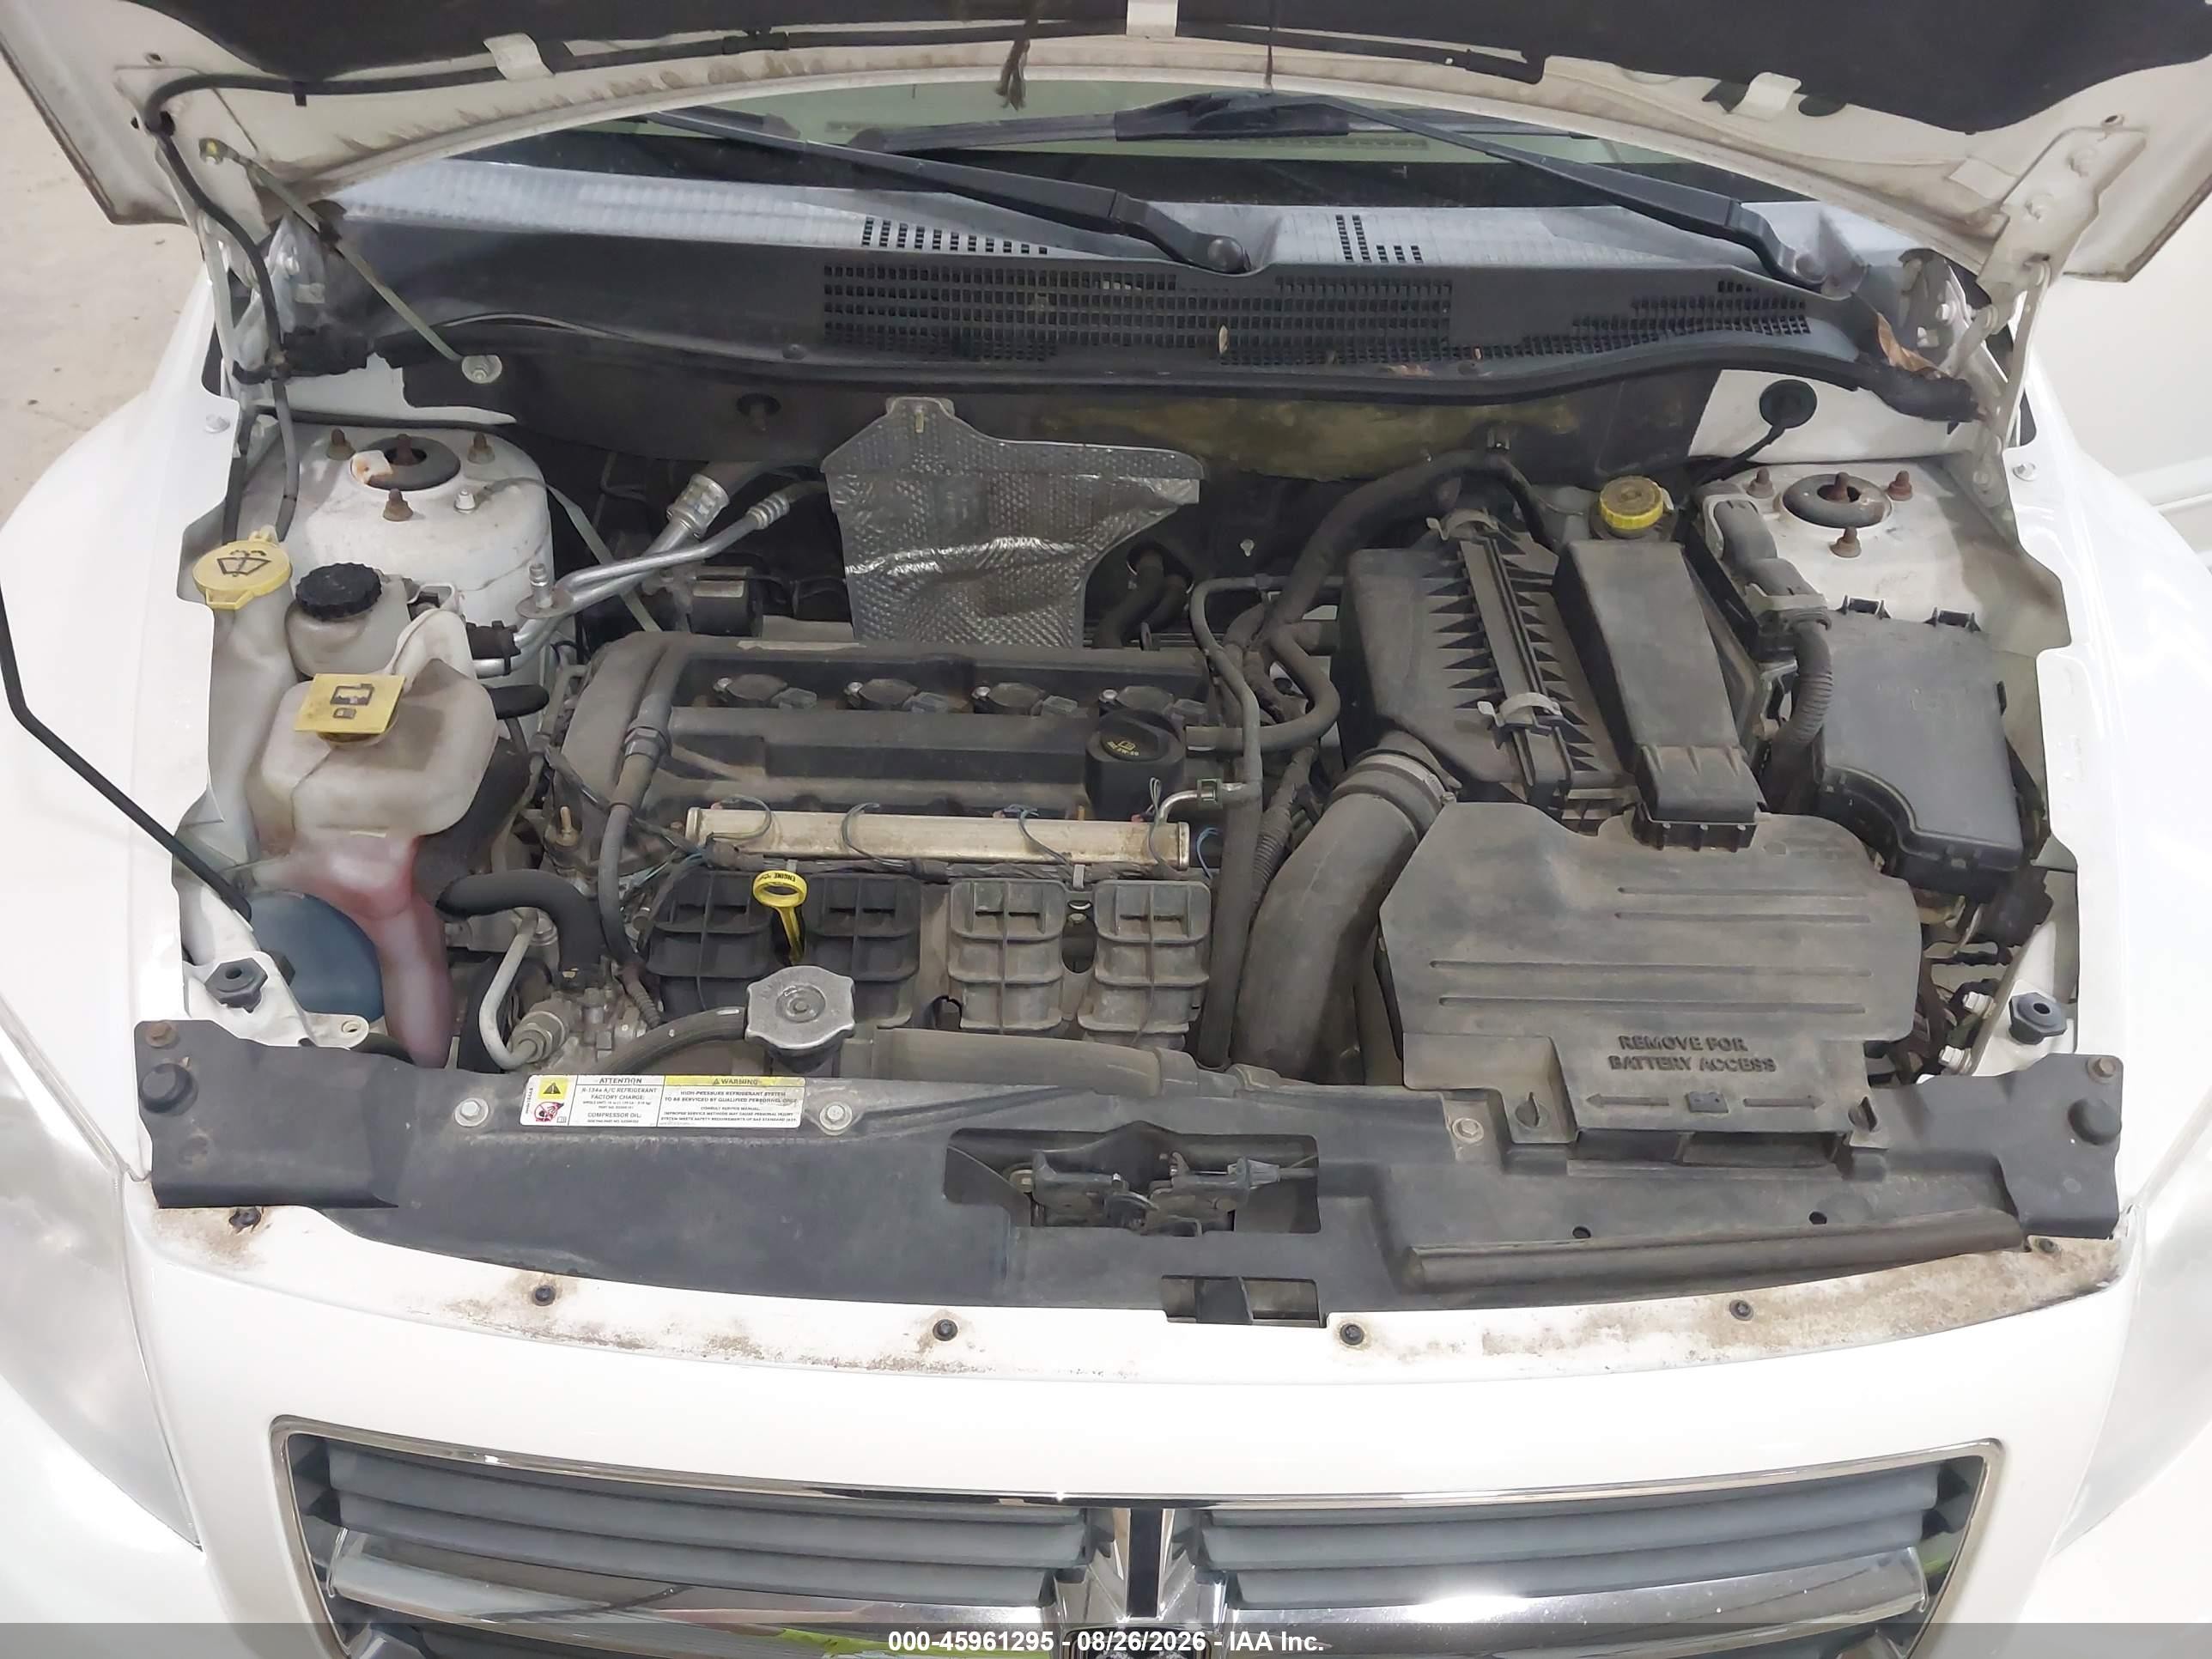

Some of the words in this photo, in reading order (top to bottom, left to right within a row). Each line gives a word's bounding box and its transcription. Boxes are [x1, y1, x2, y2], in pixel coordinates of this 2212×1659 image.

[774, 872, 796, 882] ENGINE
[1618, 1035, 1703, 1051] REMOVE
[1705, 1037, 1748, 1052] FOR
[1607, 1055, 1693, 1072] BATTERY
[1698, 1057, 1777, 1073] ACCESS
